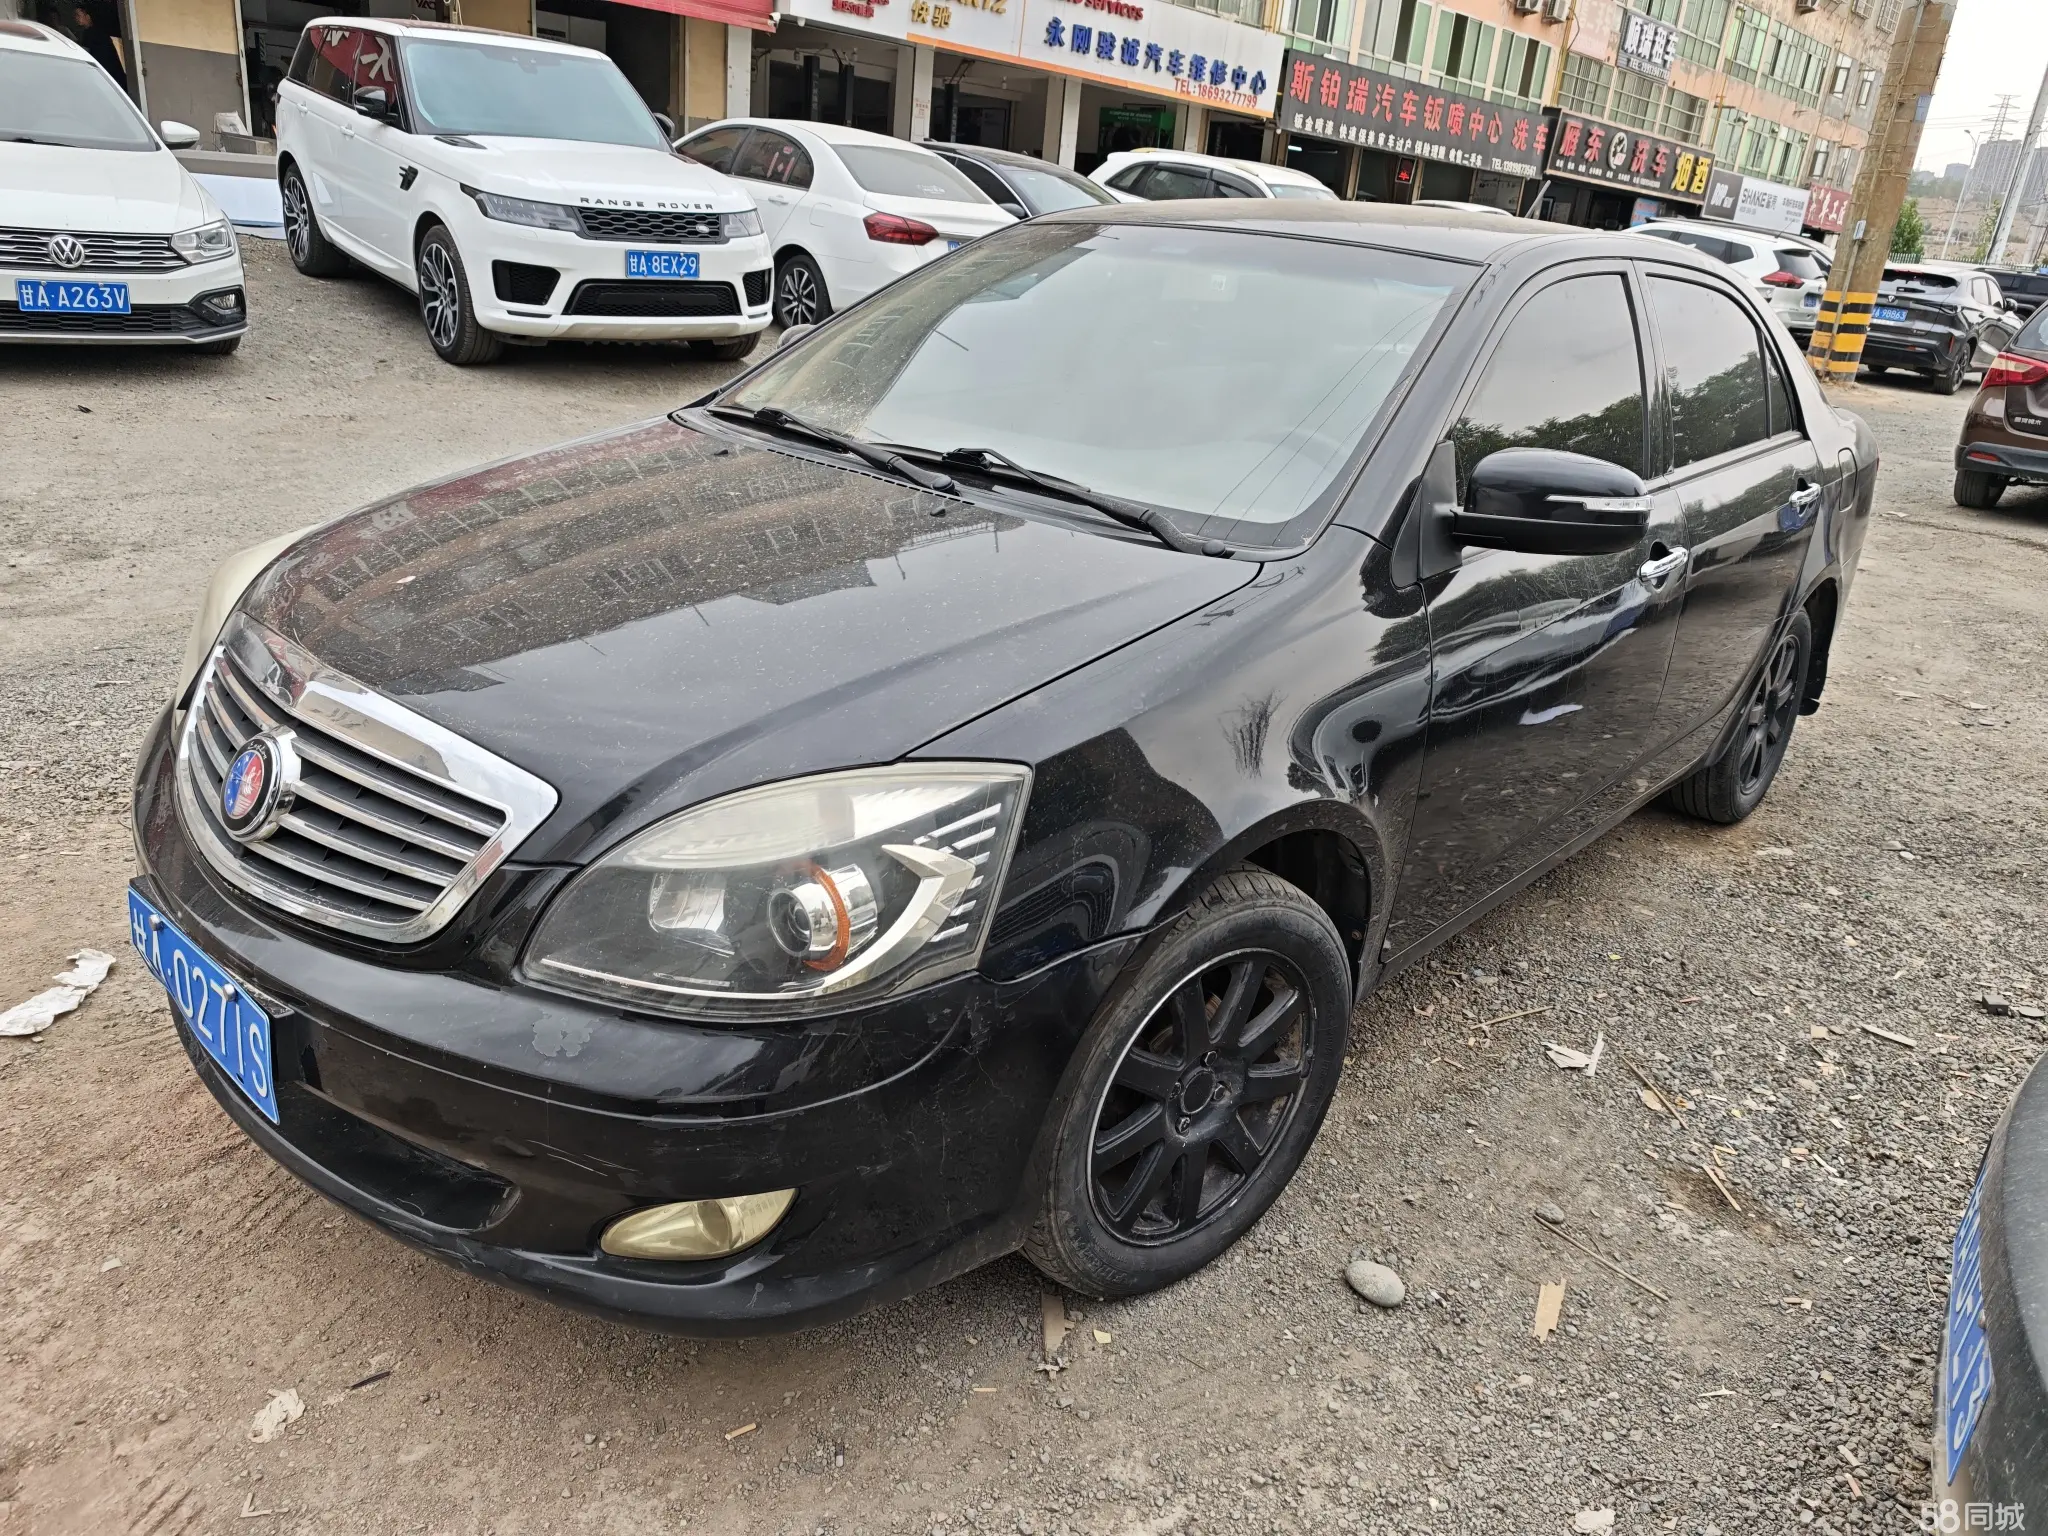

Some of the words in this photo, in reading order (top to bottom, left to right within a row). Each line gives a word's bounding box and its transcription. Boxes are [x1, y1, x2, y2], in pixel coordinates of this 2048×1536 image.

[1044, 16, 1267, 96] 永刚骏诚汽车维修中心
[1174, 76, 1258, 108] TEL:18693277799
[1511, 118, 1549, 156] 洗车
[1629, 138, 1671, 178] 洗车
[1671, 150, 1713, 195] 烟酒
[579, 196, 645, 208] RANGE
[657, 200, 714, 210] ROVER
